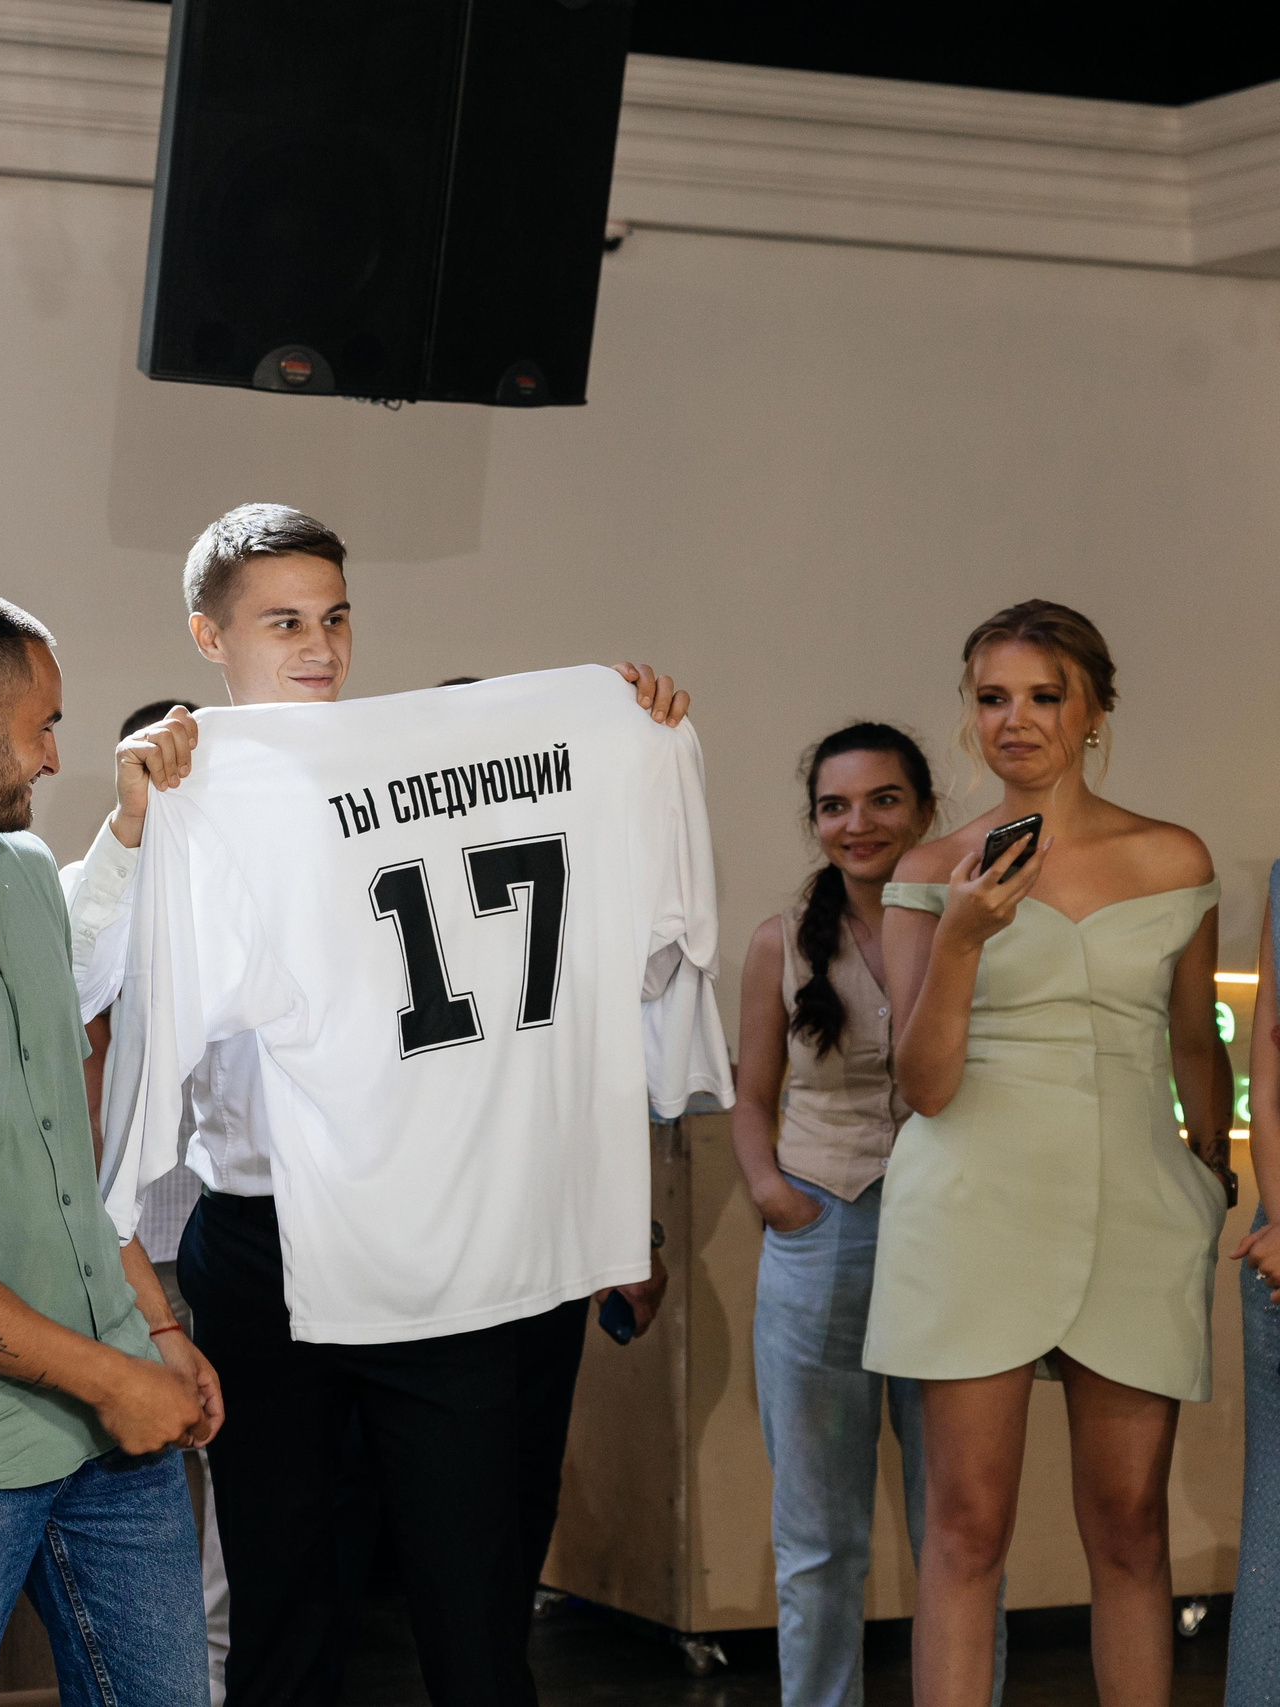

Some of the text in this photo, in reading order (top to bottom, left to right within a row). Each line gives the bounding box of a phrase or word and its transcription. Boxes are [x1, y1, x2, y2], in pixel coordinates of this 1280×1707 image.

[328, 742, 572, 839] ТЫ СЛЕДУЮЩИЙ
[367, 831, 571, 1061] 17
